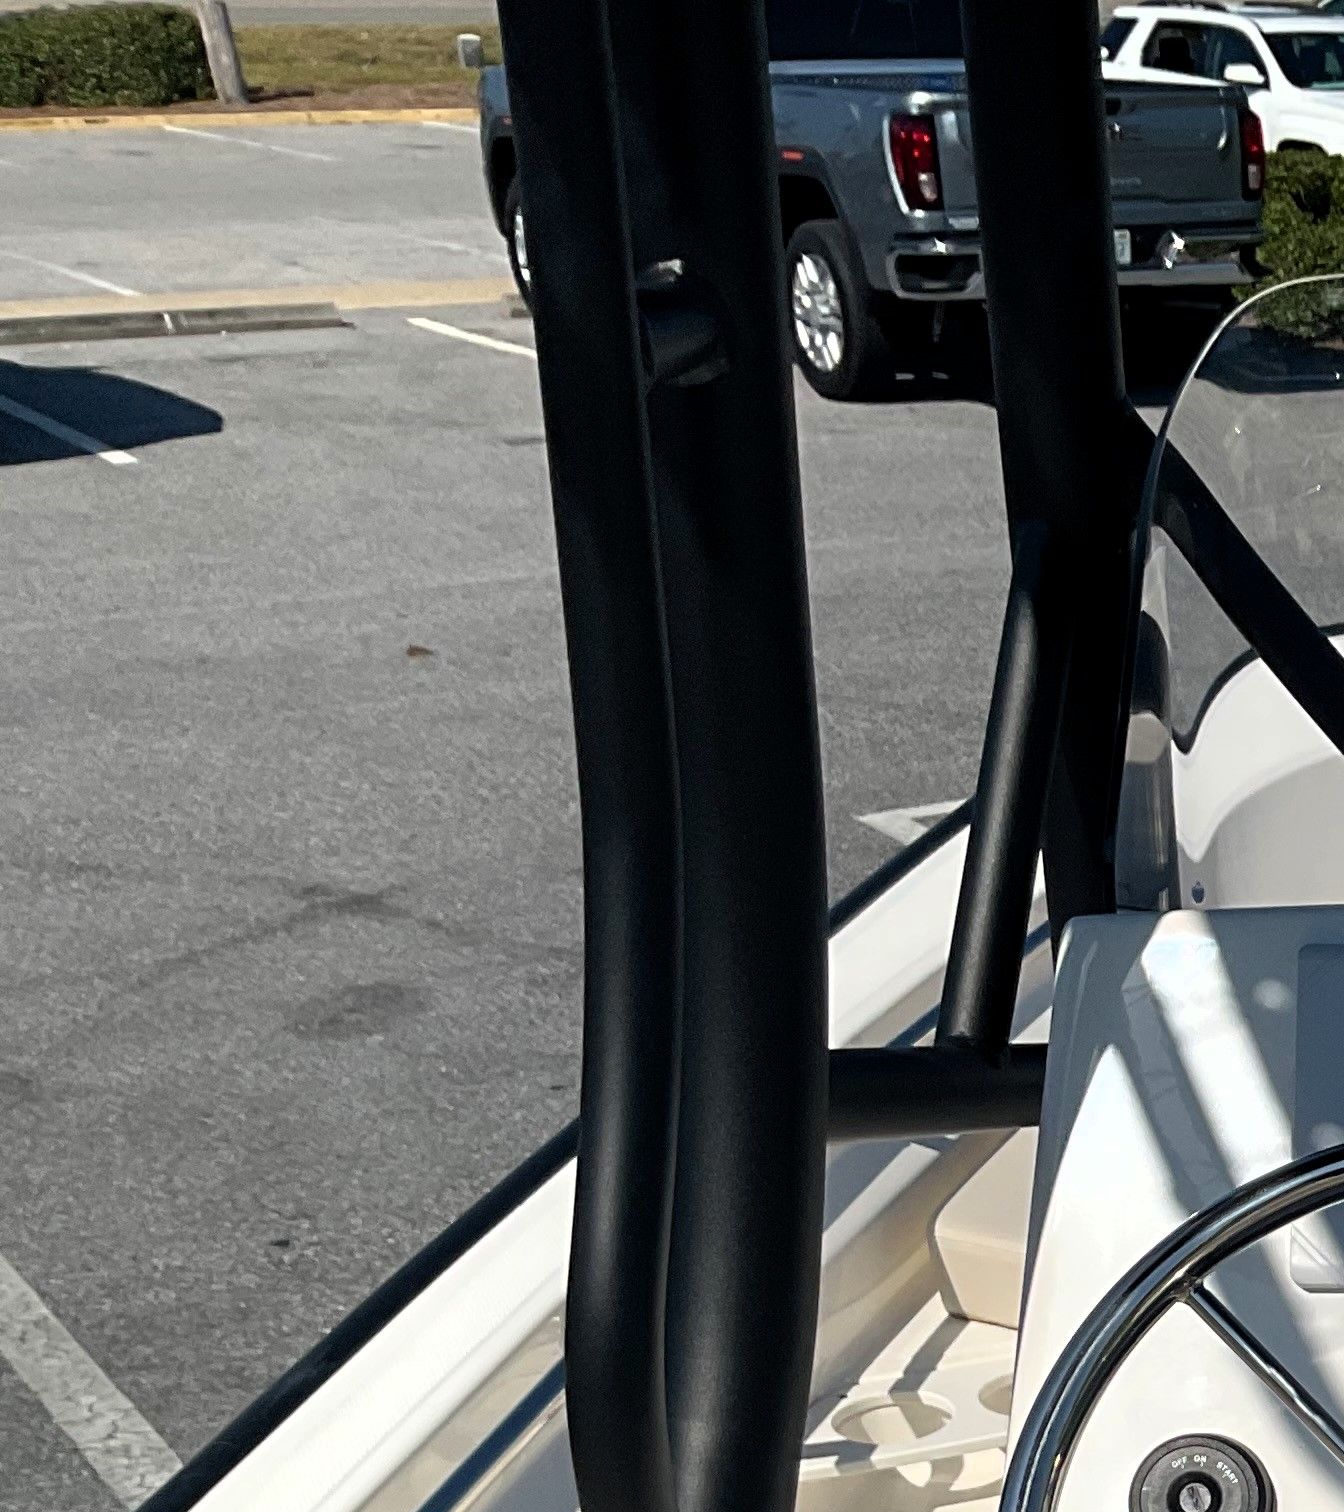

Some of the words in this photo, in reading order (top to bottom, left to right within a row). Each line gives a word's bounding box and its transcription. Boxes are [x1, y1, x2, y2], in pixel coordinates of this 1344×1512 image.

[1171, 1456, 1187, 1468] OFF
[1193, 1455, 1207, 1463] ON
[1216, 1461, 1239, 1484] START
